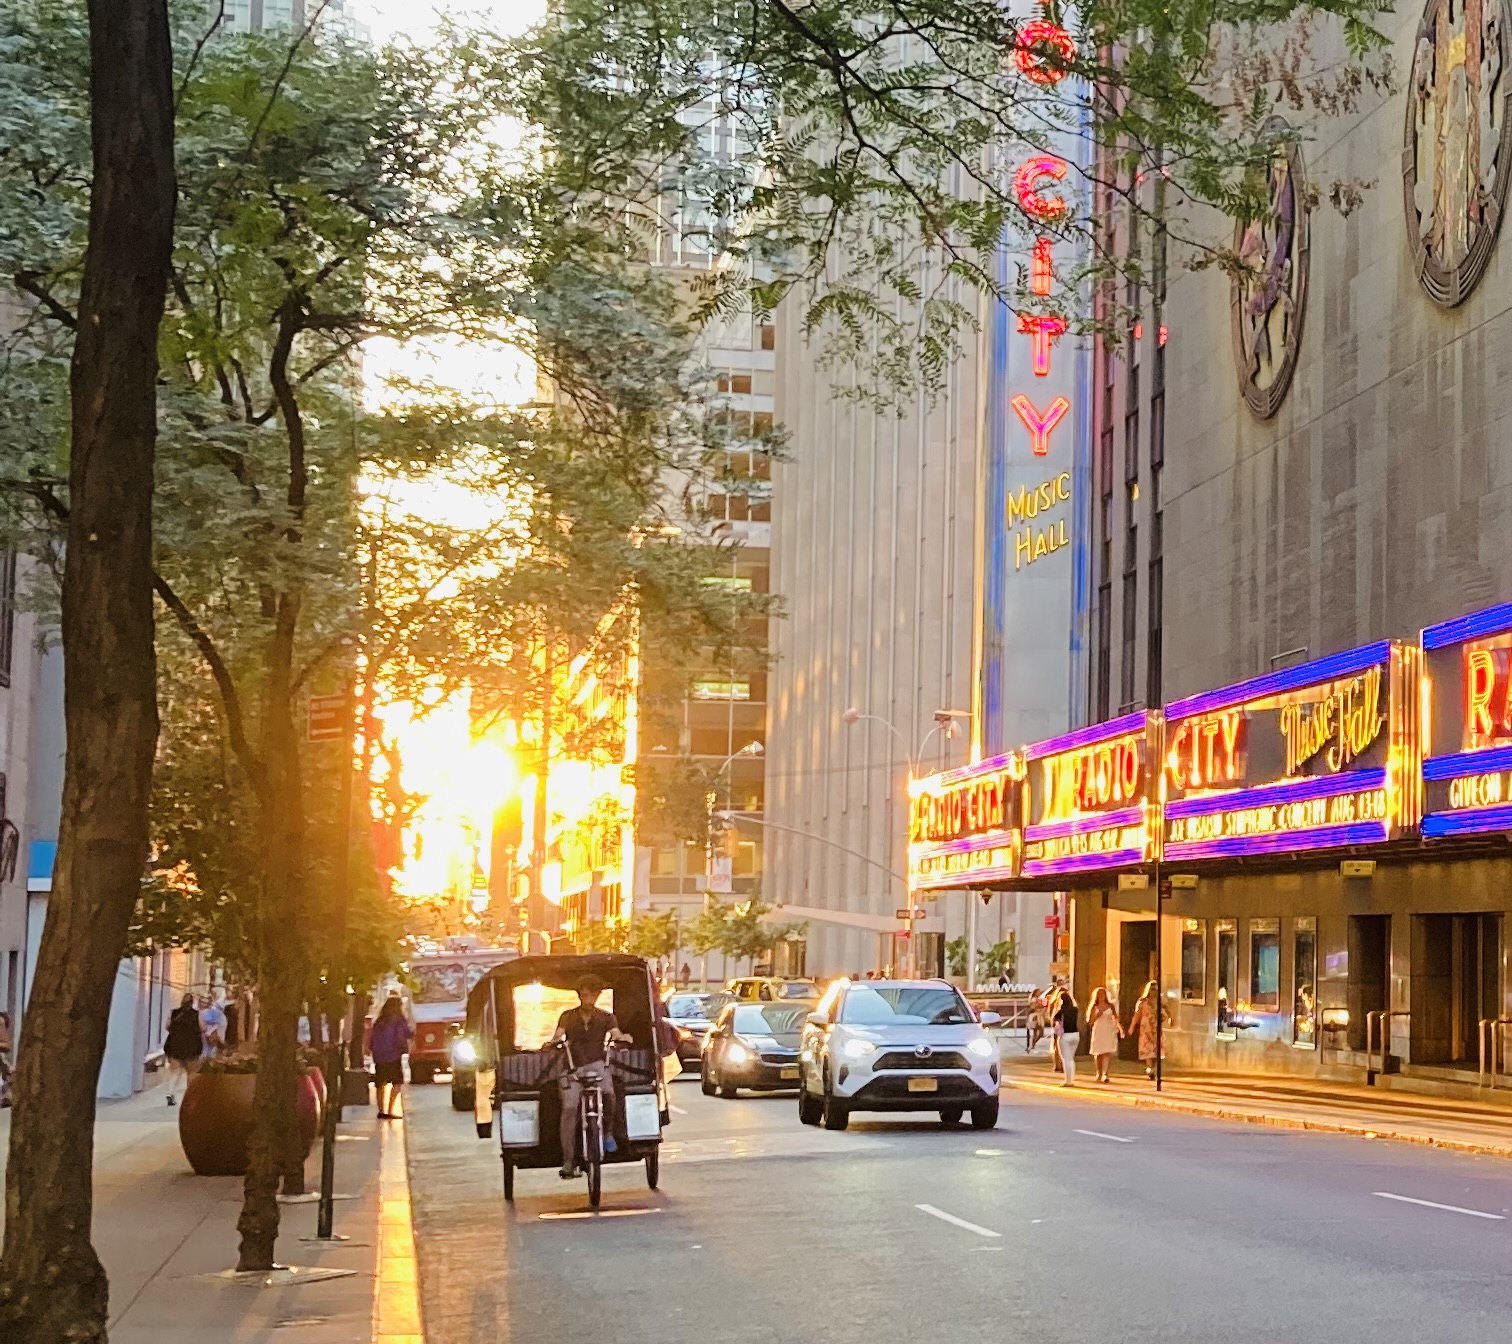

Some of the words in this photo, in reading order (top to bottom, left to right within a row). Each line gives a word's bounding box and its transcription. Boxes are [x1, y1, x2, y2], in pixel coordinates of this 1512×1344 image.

[1011, 157, 1069, 455] CITY
[1007, 471, 1070, 530] MUSIC
[1015, 518, 1069, 572] HALL
[1168, 711, 1240, 791] CITY
[1280, 693, 1335, 777] Music
[1328, 664, 1382, 773] Hall
